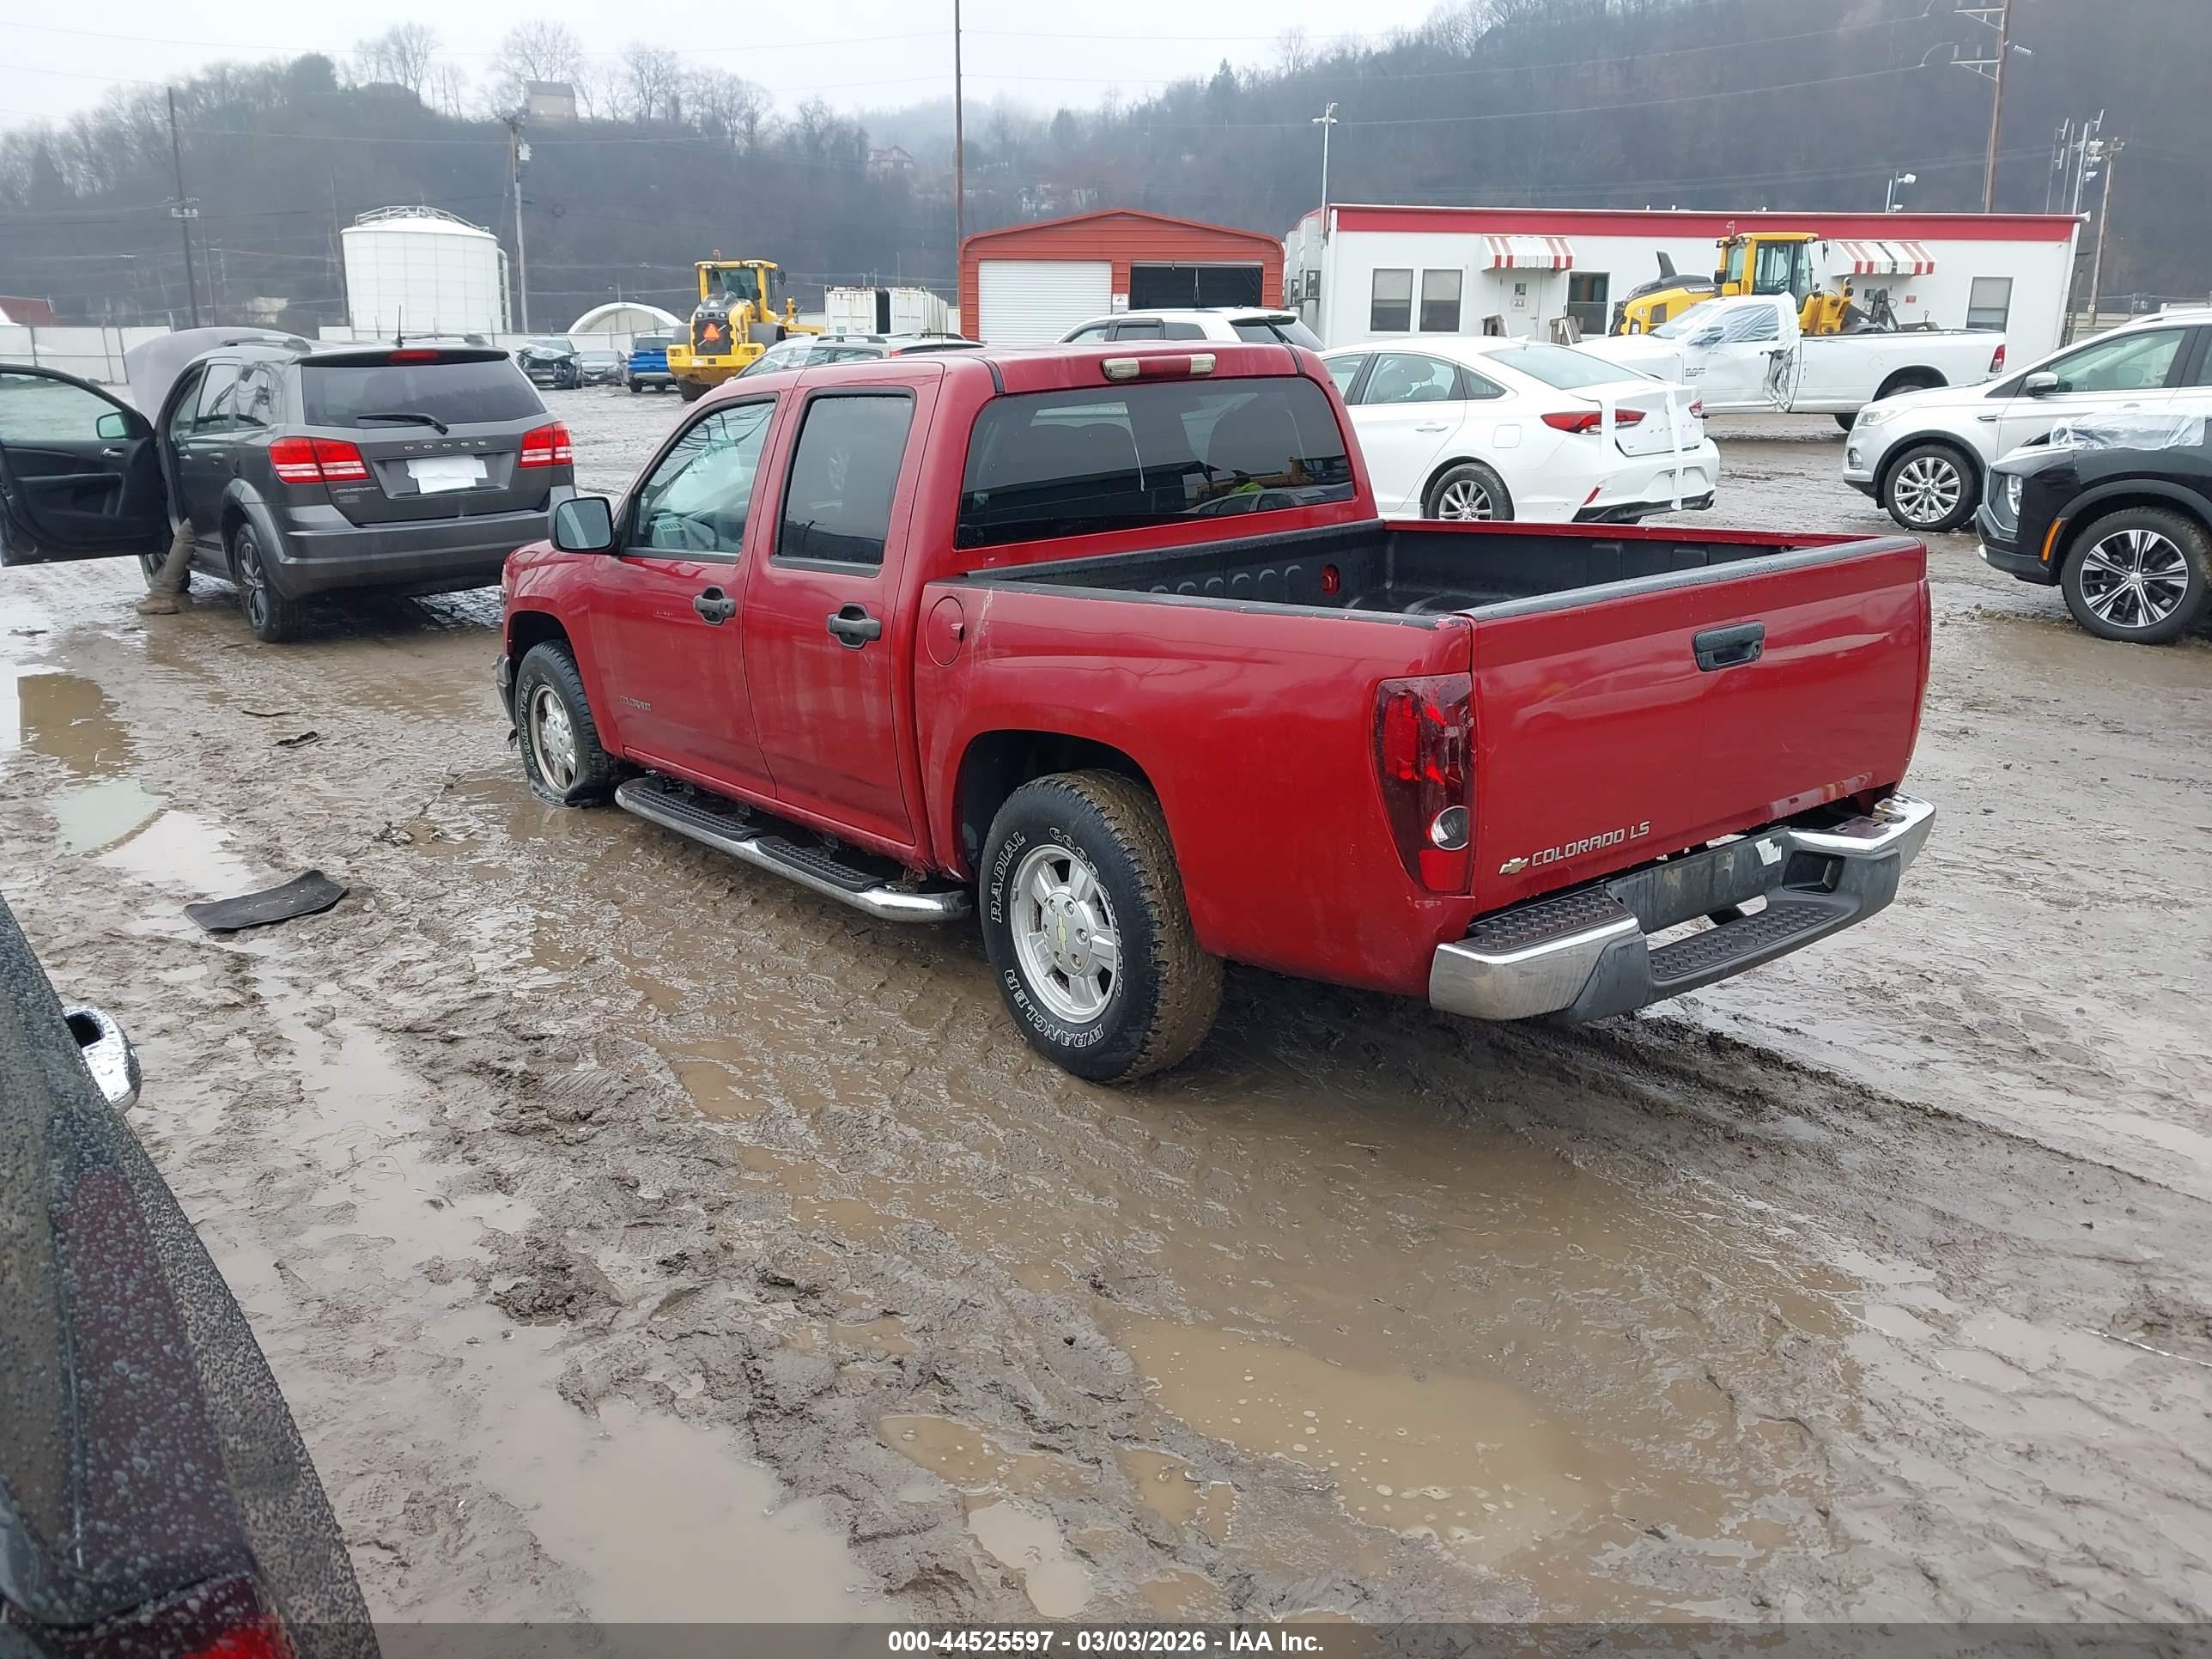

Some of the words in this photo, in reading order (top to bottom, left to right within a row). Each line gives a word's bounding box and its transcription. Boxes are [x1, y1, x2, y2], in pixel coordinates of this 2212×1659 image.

[404, 441, 487, 451] DODGE
[1531, 828, 1626, 867] COLORADO
[1629, 820, 1650, 840] LS
[990, 830, 1027, 923] RADIAL
[1004, 969, 1104, 1048] WRANGLER
